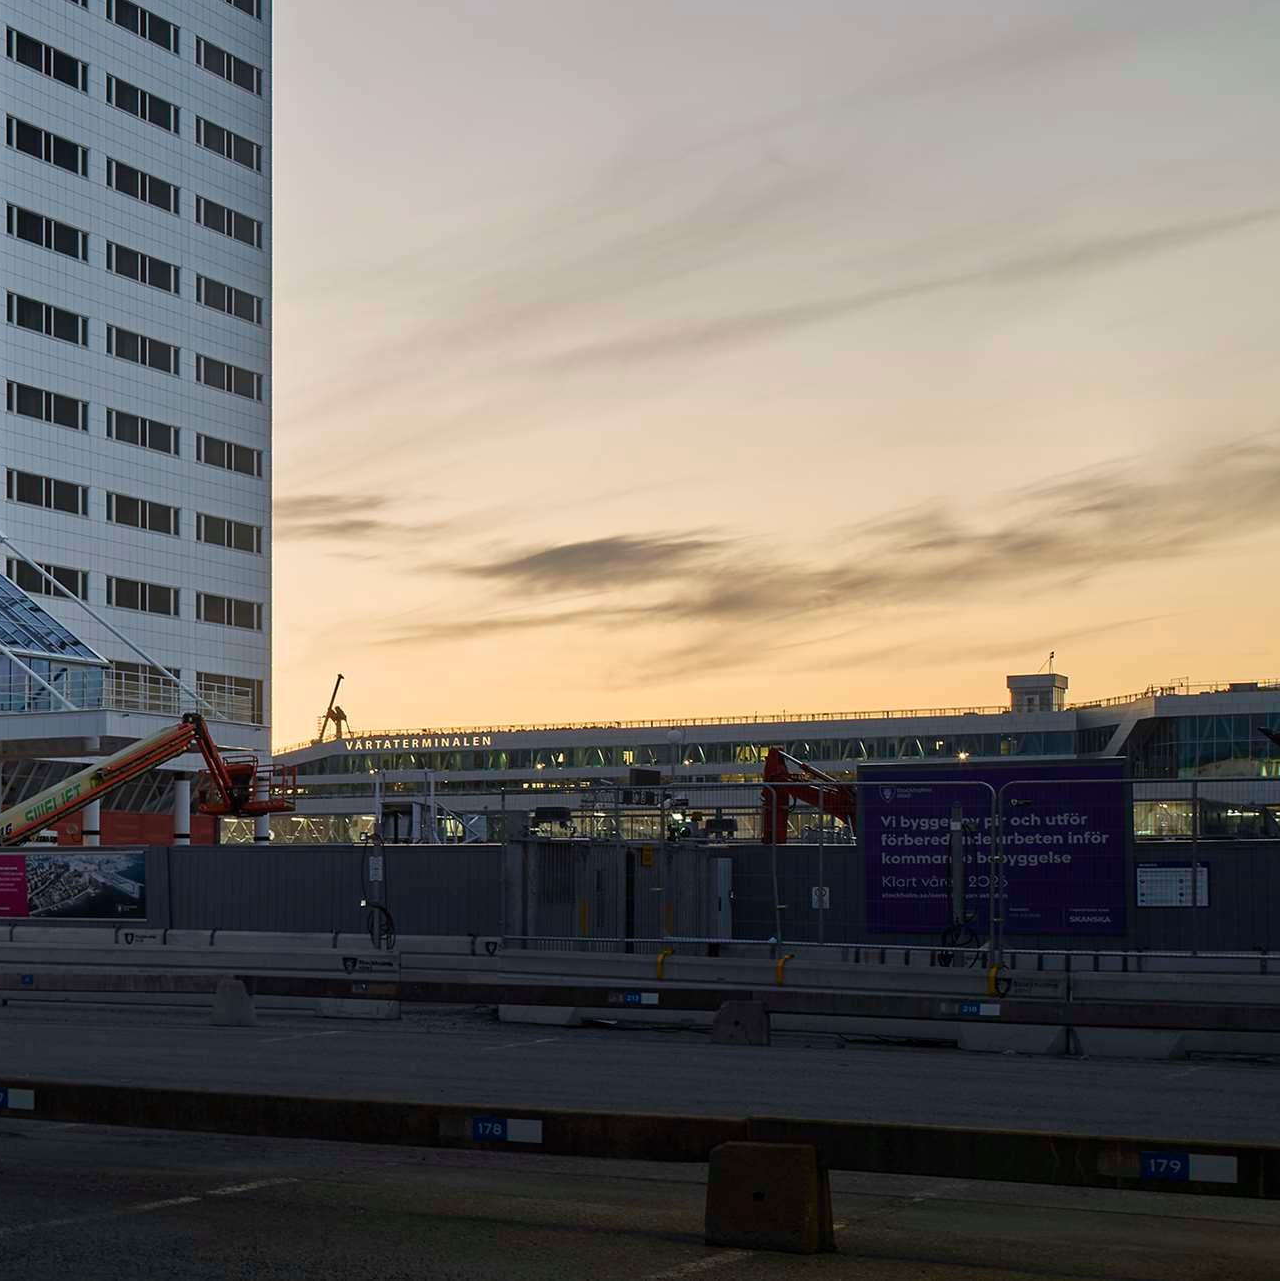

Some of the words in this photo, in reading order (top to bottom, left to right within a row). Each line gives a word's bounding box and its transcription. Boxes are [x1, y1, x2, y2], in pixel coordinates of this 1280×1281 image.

[345, 736, 492, 750] VÄRTATERMINALEN
[881, 815, 897, 828] Vi
[1010, 814, 1041, 827] och
[1045, 813, 1089, 826] utför
[881, 833, 994, 847] förberednde
[1068, 831, 1110, 844] inför
[881, 852, 973, 864] kommane
[882, 876, 918, 887] Klart
[478, 1123, 502, 1136] 178
[1149, 1158, 1182, 1174] 179
